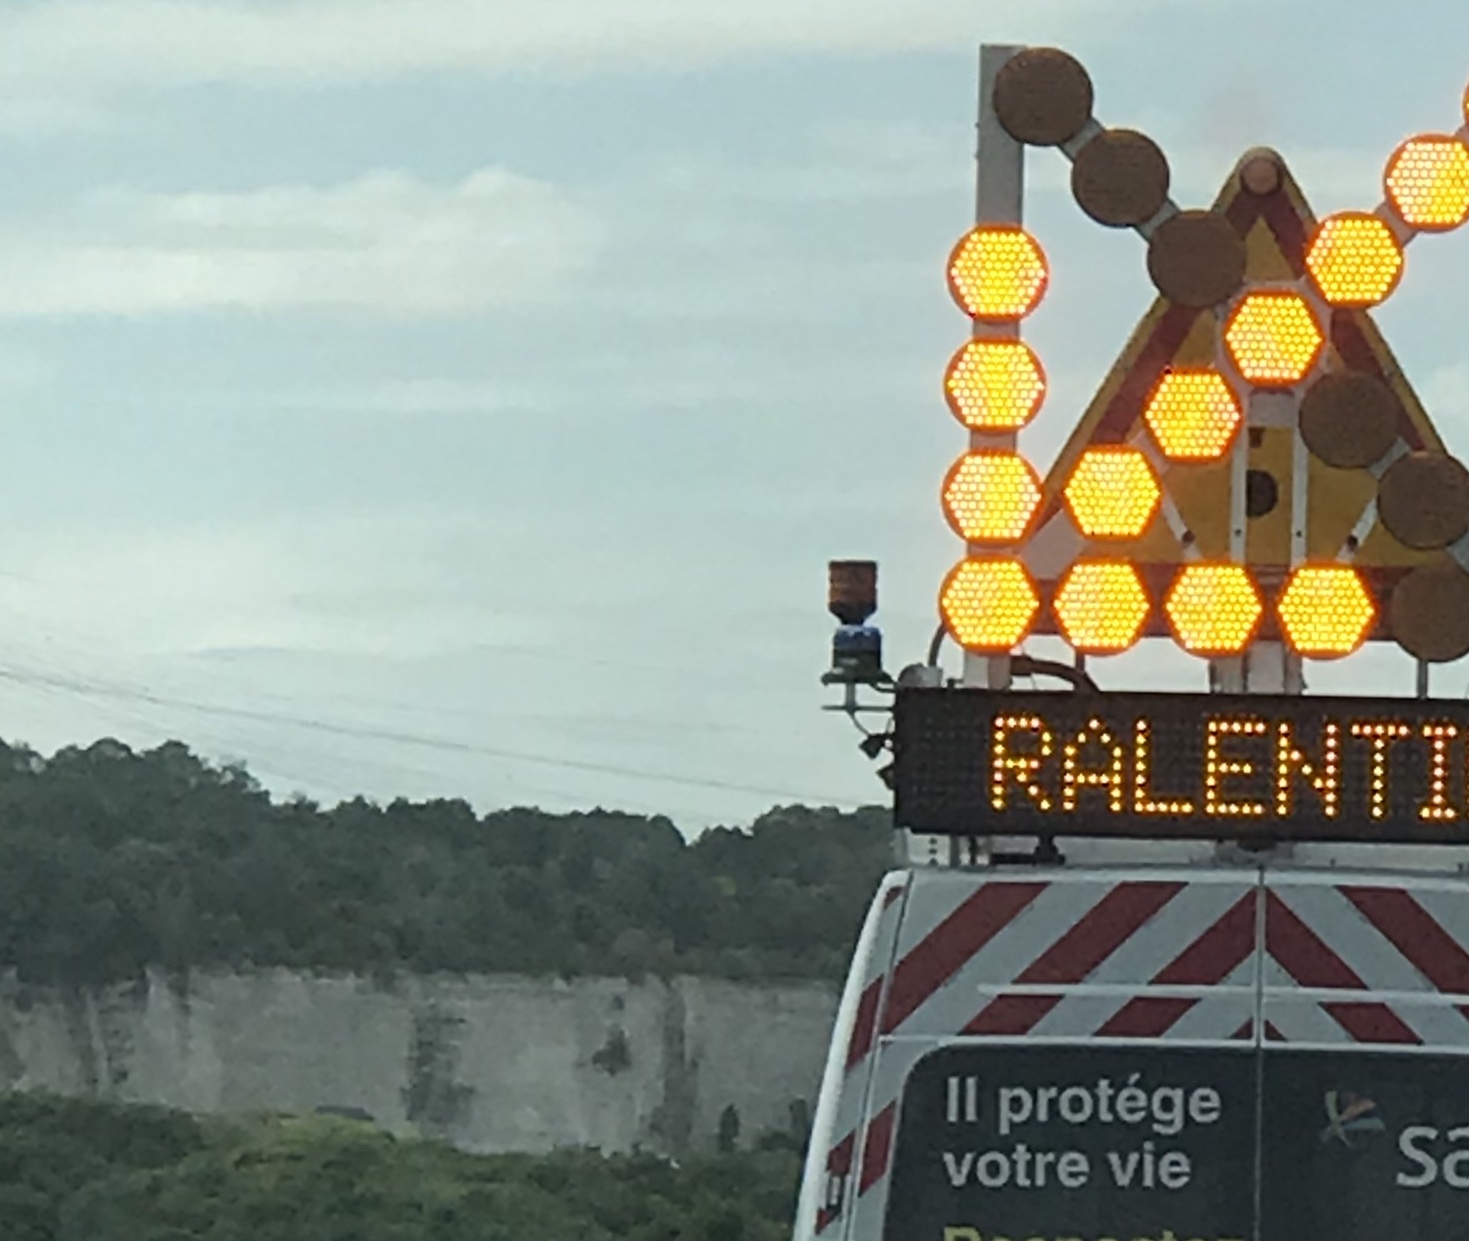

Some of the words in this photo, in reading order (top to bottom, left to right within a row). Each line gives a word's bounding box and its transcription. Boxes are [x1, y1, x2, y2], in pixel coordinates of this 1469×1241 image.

[946, 1075, 979, 1123] Il
[1000, 1072, 1222, 1135] protége
[942, 1144, 1090, 1188] votre
[1107, 1141, 1192, 1188] vie
